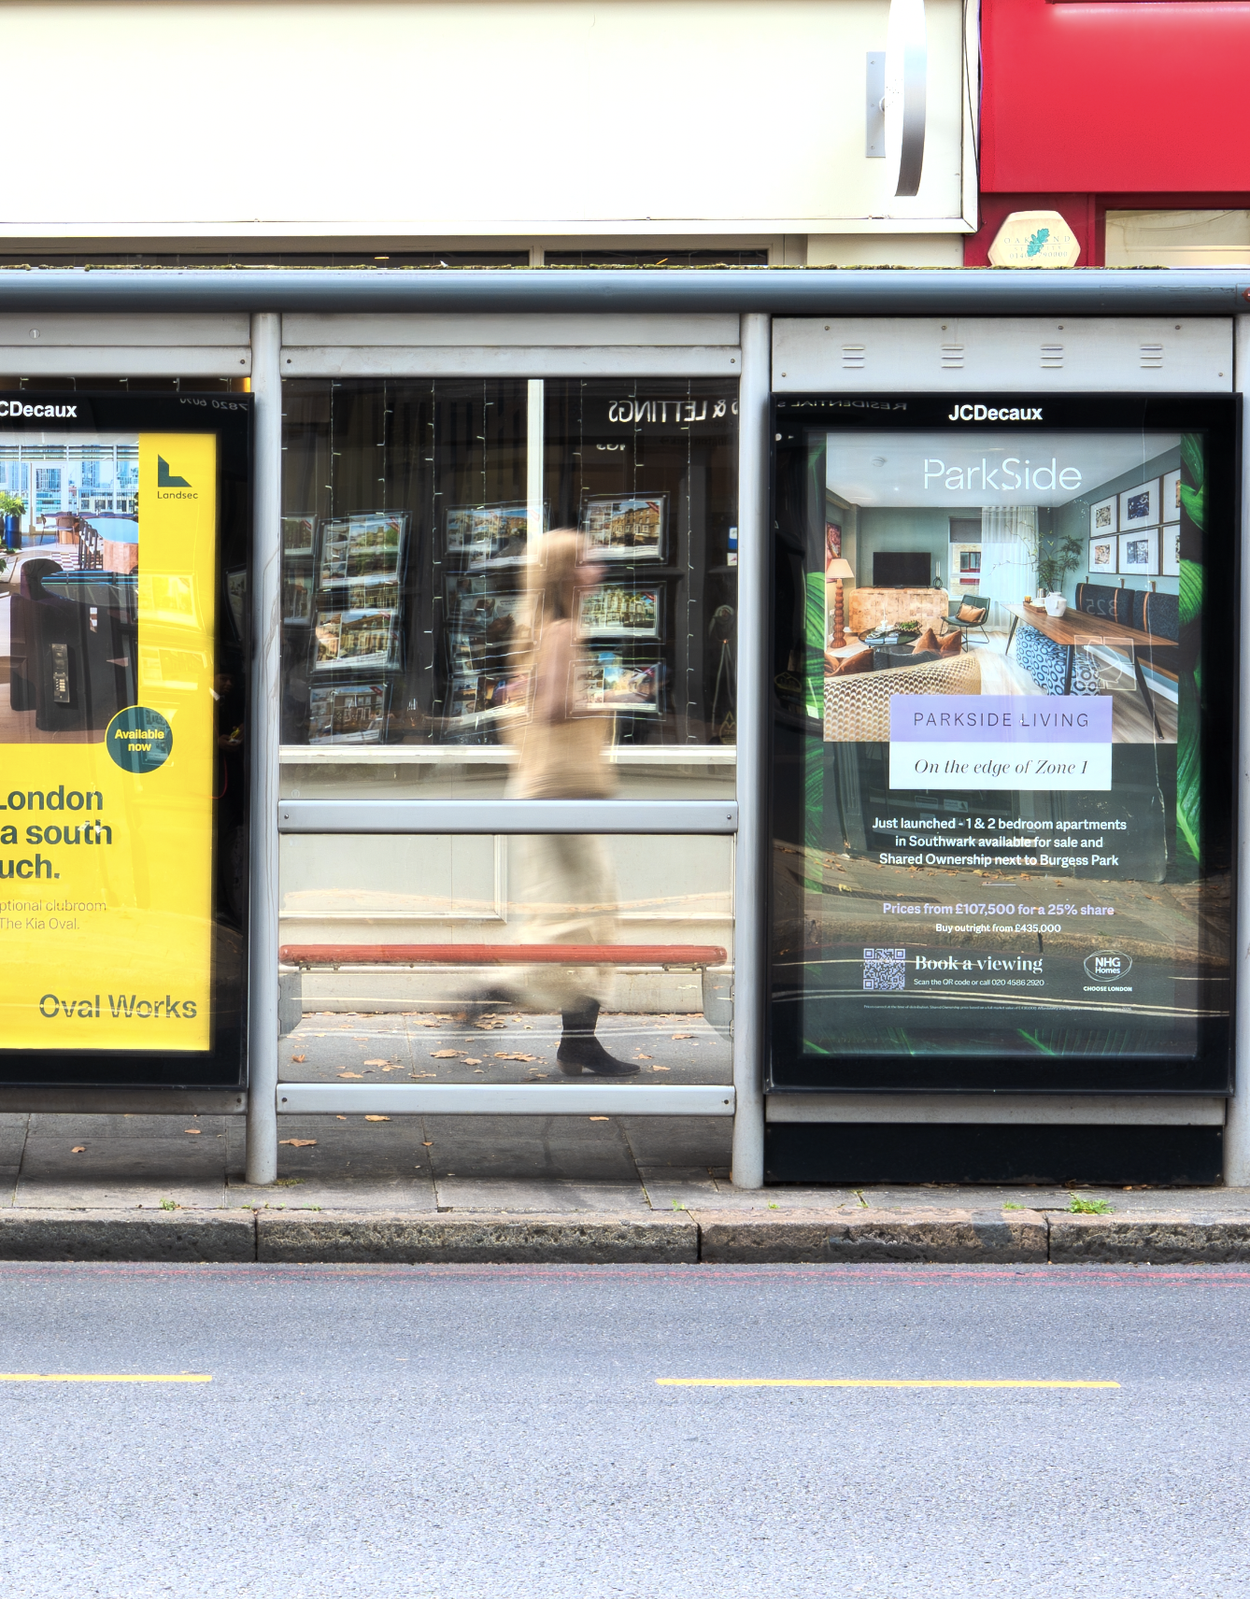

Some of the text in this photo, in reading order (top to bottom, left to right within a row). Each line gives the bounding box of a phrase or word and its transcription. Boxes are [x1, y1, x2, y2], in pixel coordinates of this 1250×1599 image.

[949, 404, 1043, 421] JCDecaux
[924, 458, 1082, 490] ParkSide
[157, 490, 198, 500] Landsec
[914, 713, 1088, 727] PARKSIDE LIVING
[114, 728, 165, 740] Available
[128, 743, 152, 752] now
[915, 759, 939, 773] On
[945, 760, 969, 773] the
[974, 760, 1010, 777] edge
[1015, 760, 1032, 773] of
[1036, 760, 1076, 774] Zone
[872, 818, 898, 829] Just
[901, 818, 956, 830] launched
[966, 818, 972, 829] 1
[974, 818, 985, 829] &
[988, 818, 996, 829] 2
[999, 818, 1053, 830] bedroom
[1055, 820, 1127, 833] apartments
[0, 826, 18, 845] a
[26, 820, 112, 845] south
[895, 836, 1103, 848] in Southwark available for sale and
[879, 853, 1119, 868] Shared Ownership next to Burgess Park
[46, 900, 107, 911] clubroom
[883, 903, 1115, 916] Prices from £107,500 for a 25% share
[26, 918, 45, 929] Kia
[49, 918, 81, 930] Oval.
[936, 924, 1061, 935] Buy outright from £435,000
[915, 956, 1044, 974] Book a viewing
[1095, 957, 1121, 967] NHG
[1095, 966, 1121, 974] Homes
[913, 978, 931, 986] Scan
[931, 978, 942, 986] the
[954, 978, 970, 986] code
[979, 978, 991, 986] call
[992, 979, 1006, 987] 020
[39, 994, 197, 1018] Oval Works
